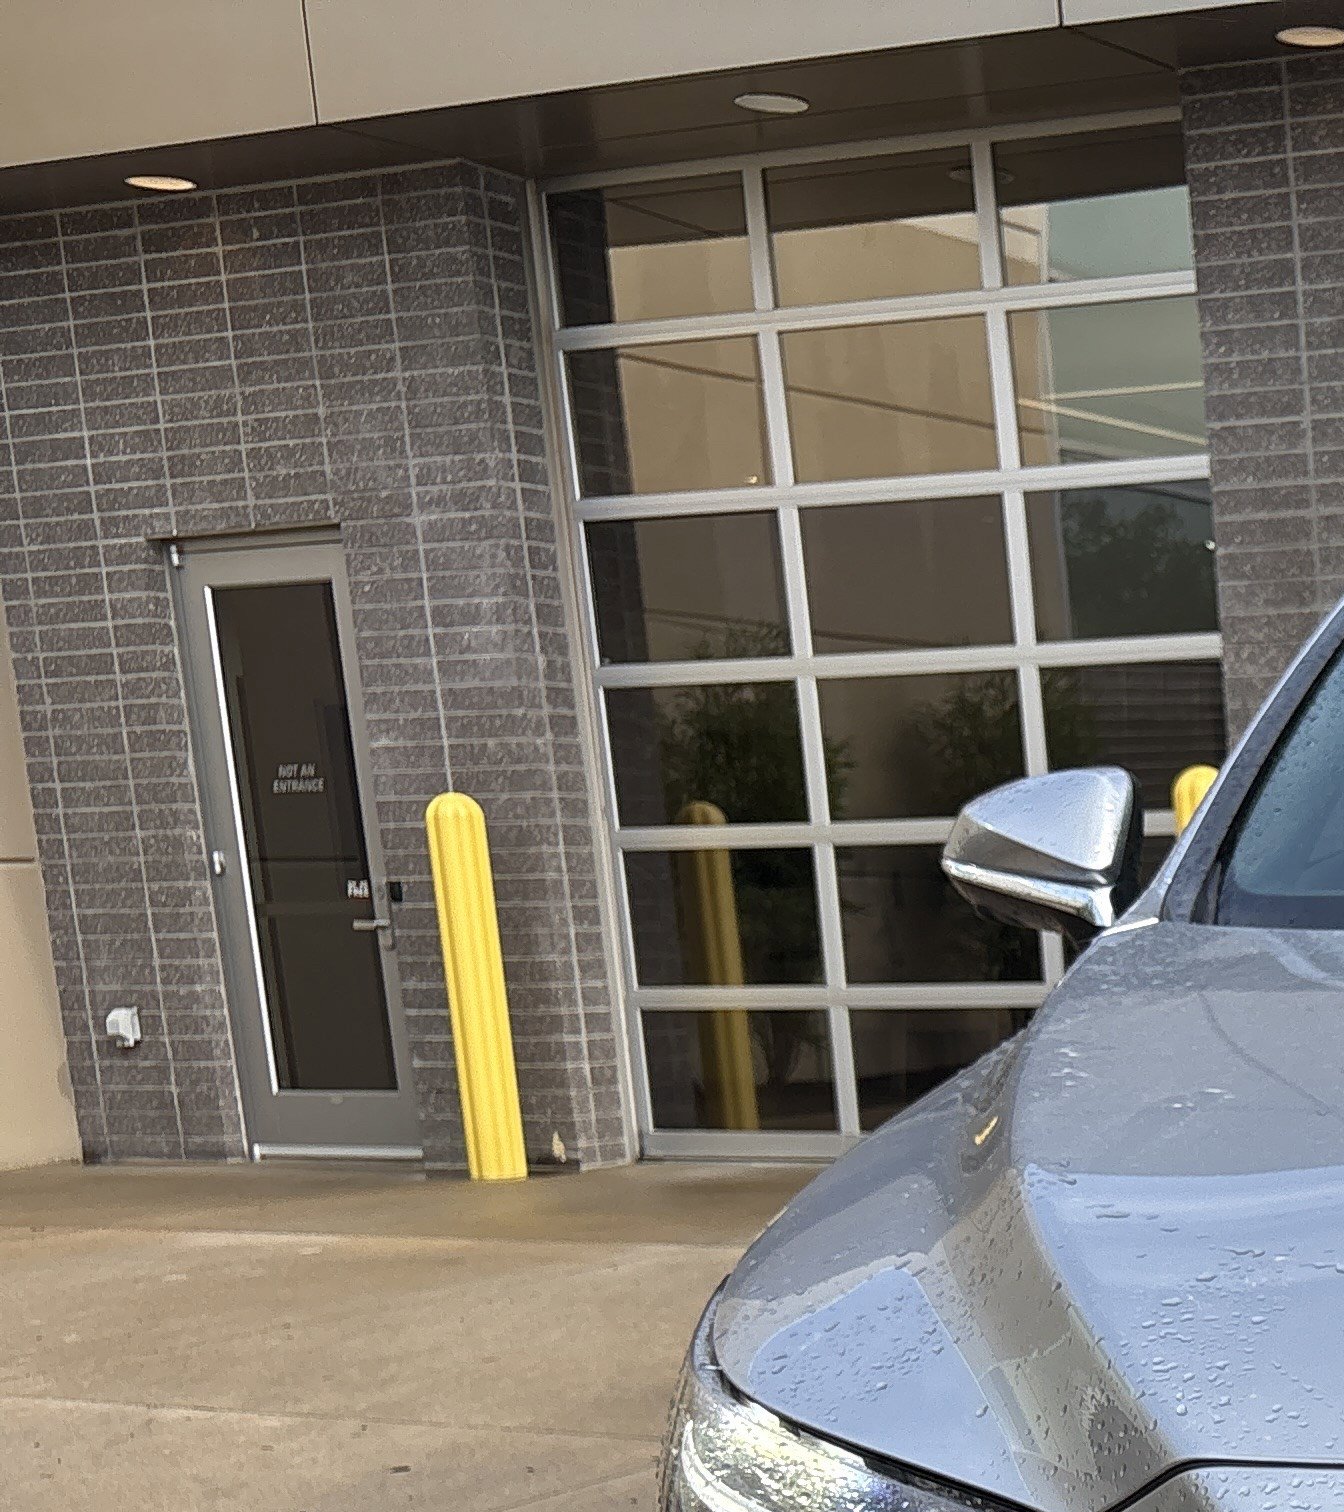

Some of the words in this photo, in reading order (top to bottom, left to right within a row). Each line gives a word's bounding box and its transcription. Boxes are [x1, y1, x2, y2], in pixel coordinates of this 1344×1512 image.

[277, 763, 299, 778] NOT
[300, 763, 316, 777] AN
[272, 778, 325, 794] ENTRANCE
